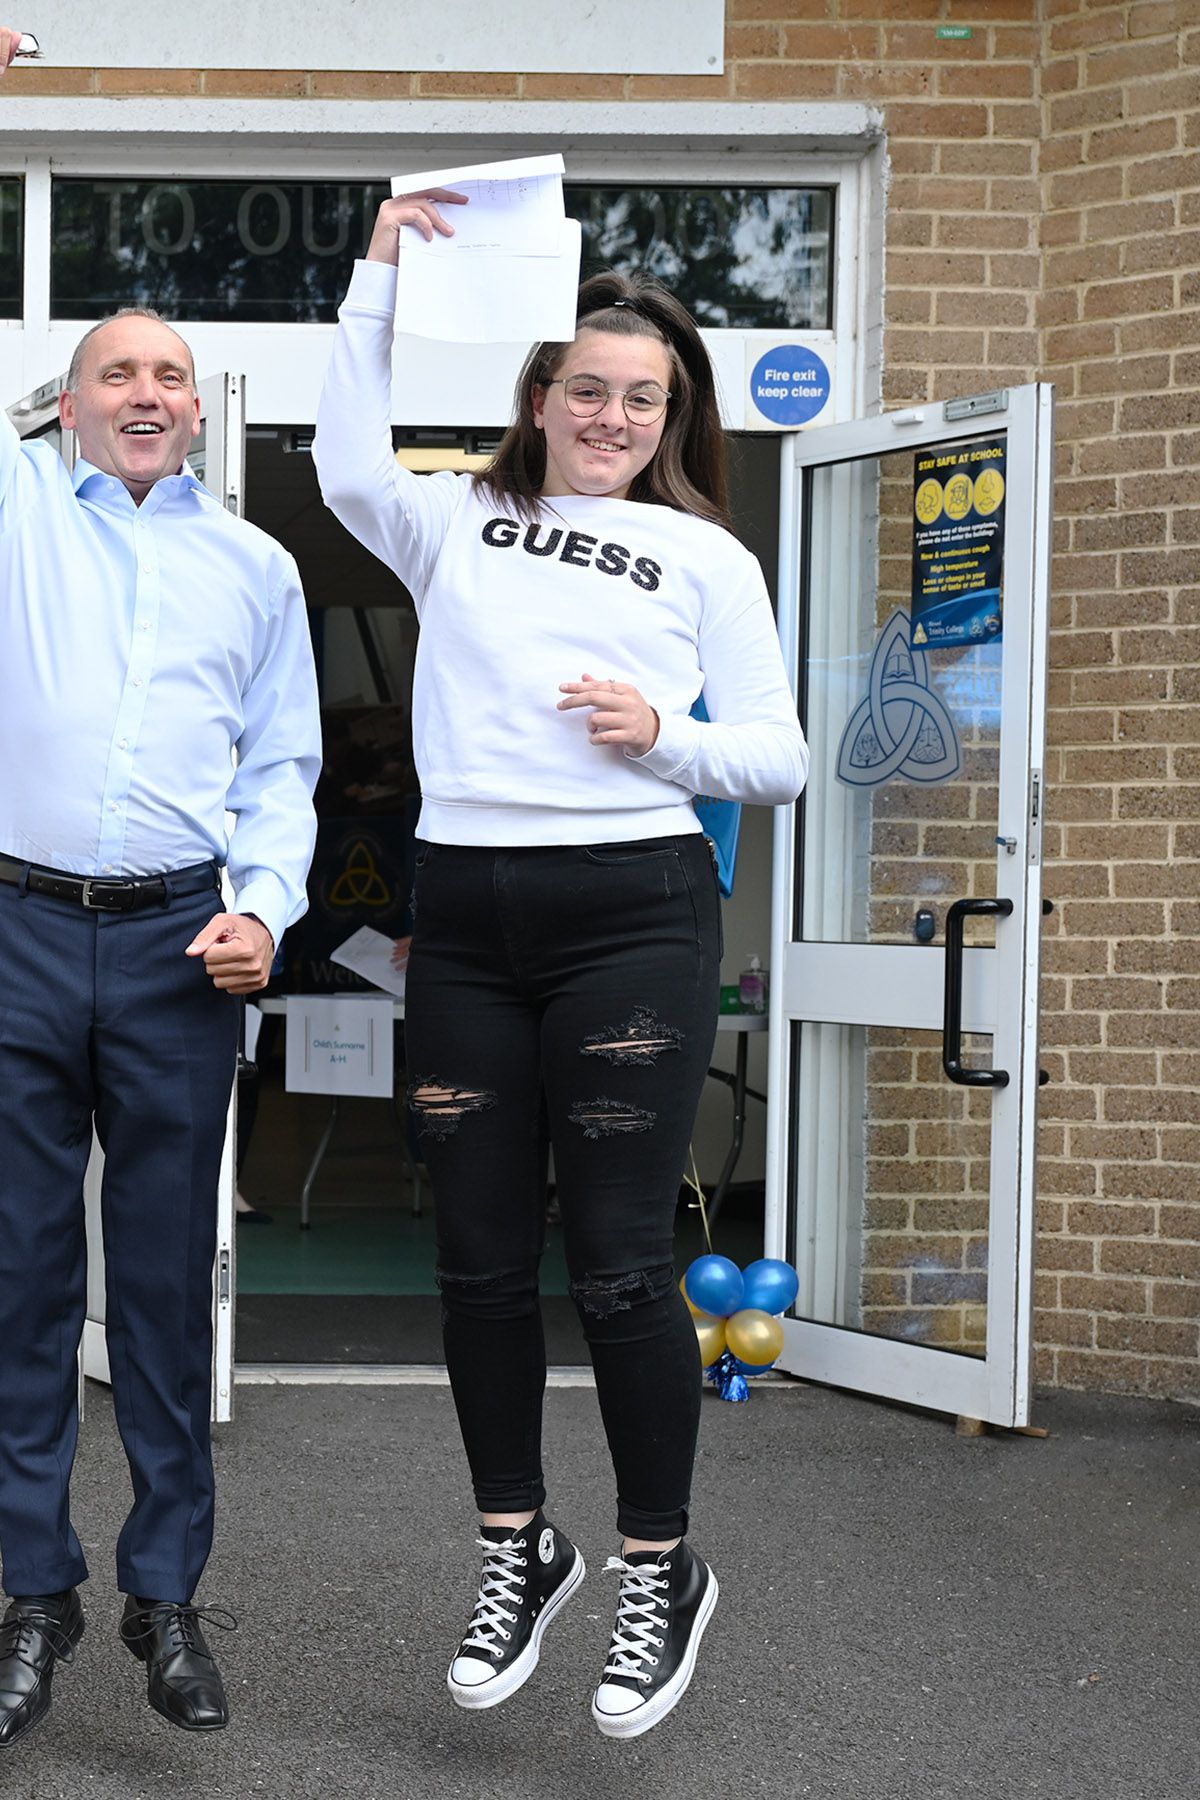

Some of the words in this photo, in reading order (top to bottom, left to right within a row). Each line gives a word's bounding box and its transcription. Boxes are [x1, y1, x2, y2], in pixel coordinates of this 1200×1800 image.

[93, 184, 196, 256] TO
[239, 184, 376, 257] OU
[765, 369, 790, 381] Fire
[792, 369, 816, 381] exit
[757, 386, 788, 400] keep
[791, 386, 823, 397] clear
[919, 459, 936, 471] STAY
[936, 455, 957, 468] SAFE
[958, 453, 969, 464] AT
[970, 448, 1004, 462] SCHOOL
[951, 533, 964, 541] enter
[482, 517, 662, 592] GUESS
[971, 543, 991, 554] cough
[930, 564, 944, 573] High
[945, 560, 979, 571] temperature
[923, 578, 937, 586] Loss
[945, 574, 965, 584] change
[972, 571, 986, 580] your
[923, 586, 940, 594] sense
[334, 1040, 365, 1050] Surname
[330, 1054, 346, 1064] A-H
